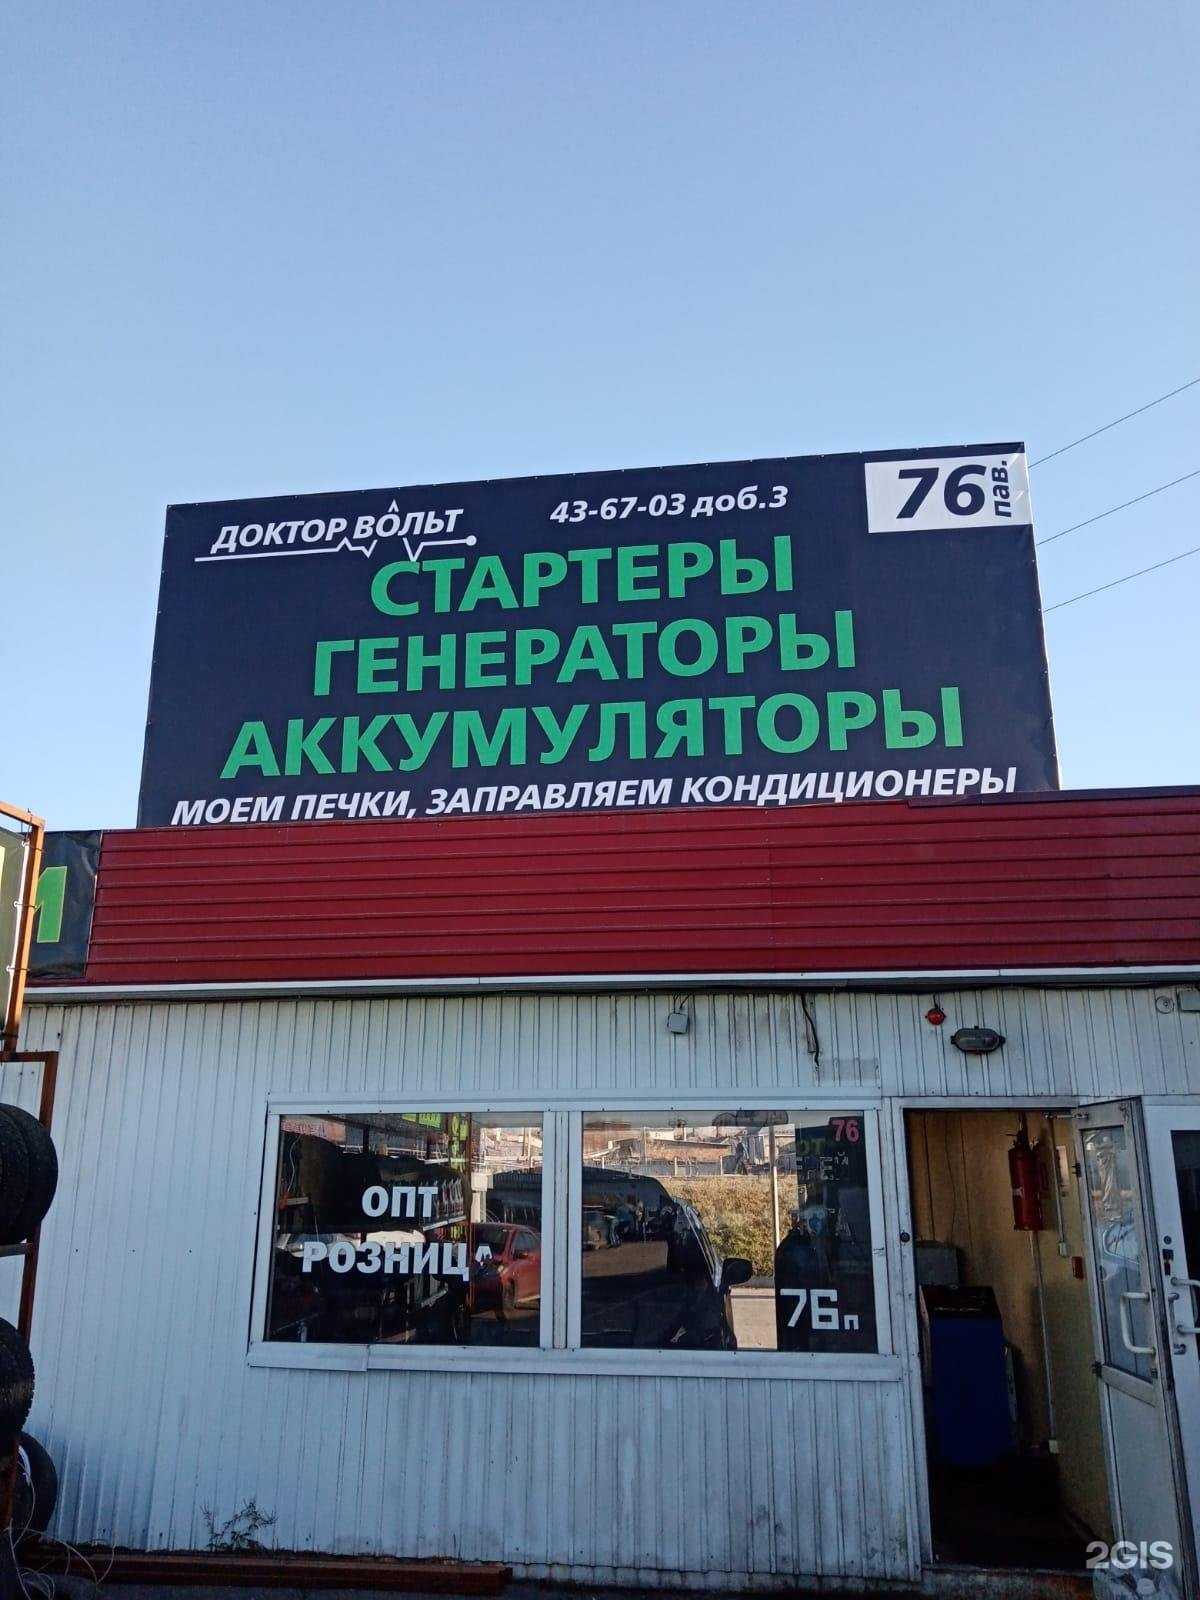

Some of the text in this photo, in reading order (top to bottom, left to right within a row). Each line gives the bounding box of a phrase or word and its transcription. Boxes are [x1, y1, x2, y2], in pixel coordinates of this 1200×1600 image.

[549, 485, 789, 523] 43-67-03 доб.3
[896, 464, 986, 519] 76
[991, 460, 1012, 517] пав.
[210, 508, 464, 554] ДОКТОР ВОЛЬТ
[370, 535, 793, 616] СТАРТЕРЫ
[313, 610, 856, 696] ГЕНЕРАТОРЫ
[219, 687, 963, 779] АККУМУЛЯТОРЫ
[170, 767, 1017, 826] МОЕМ ПЕЧКИ, ЗАПРАВЛЯЕМ КОНДИЦИОНЕРЫ
[830, 1118, 860, 1143] 76
[361, 1185, 439, 1217] ОПТ
